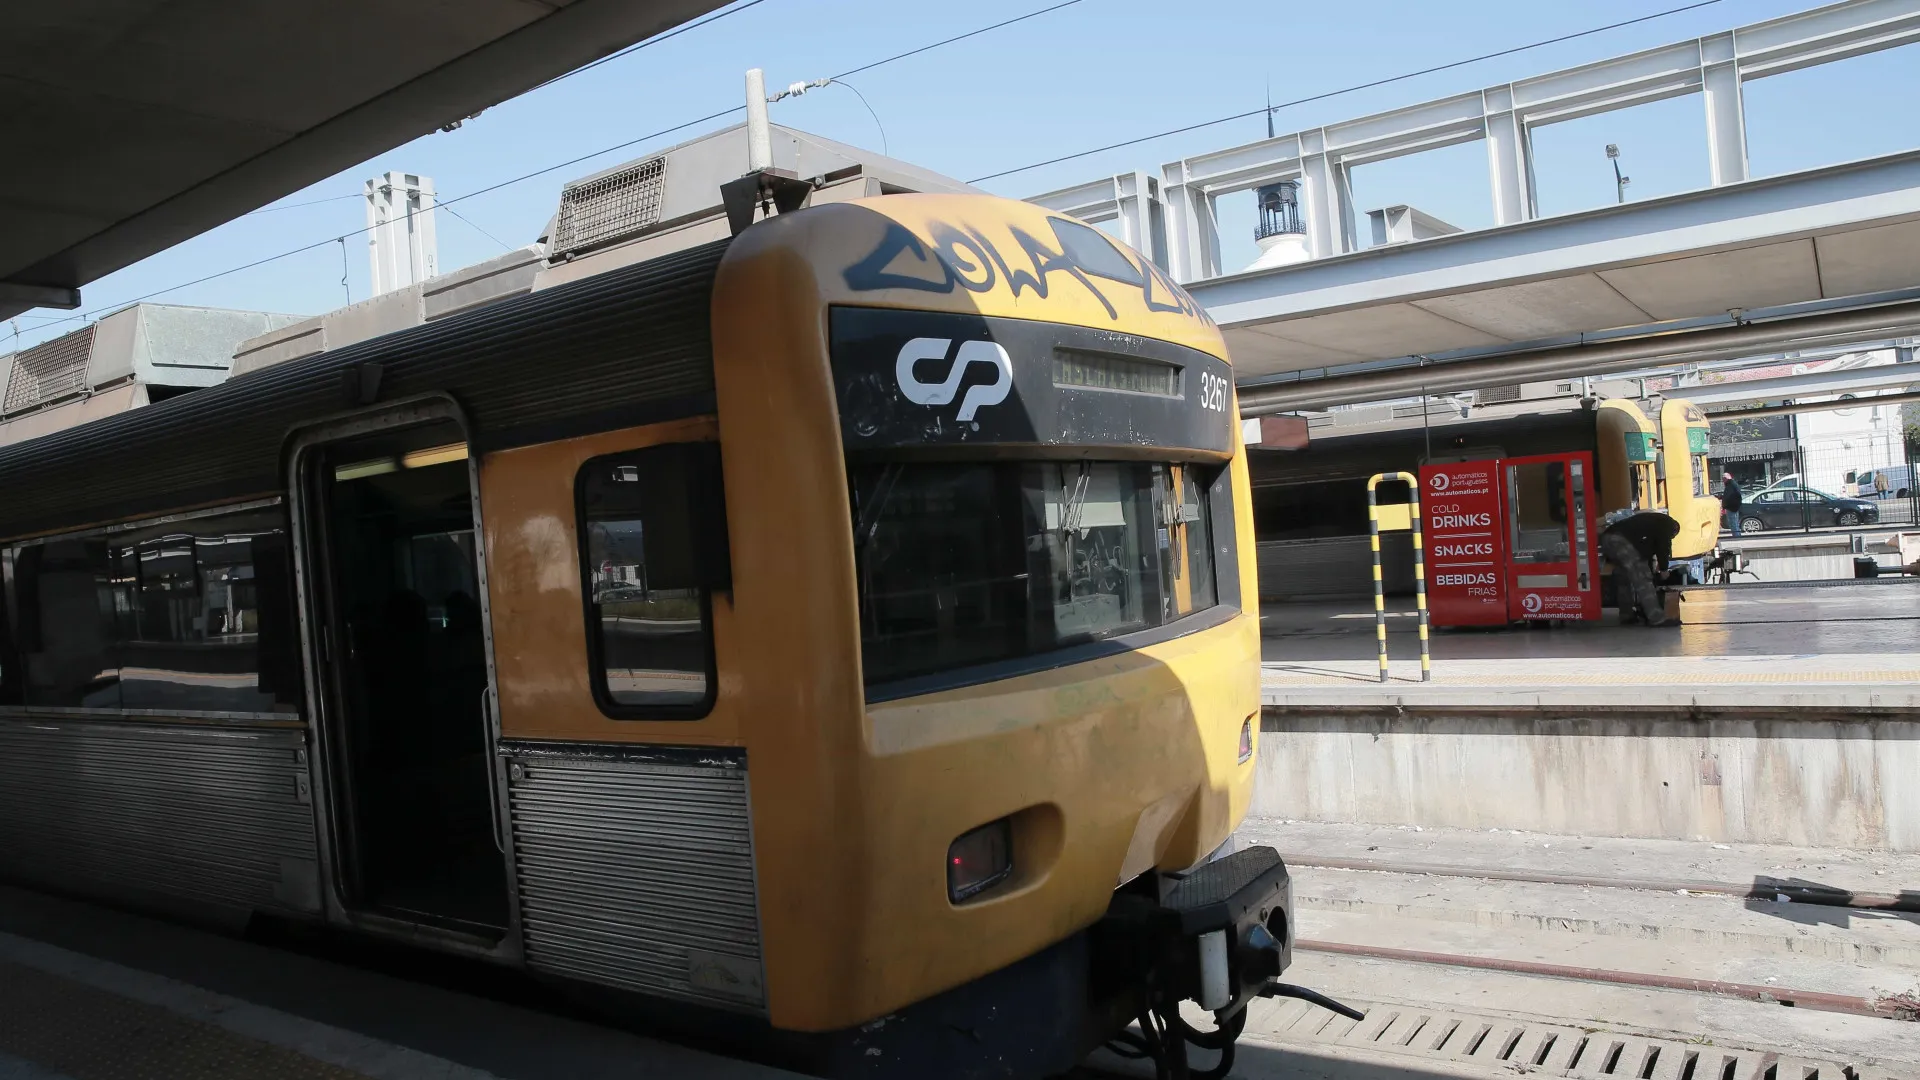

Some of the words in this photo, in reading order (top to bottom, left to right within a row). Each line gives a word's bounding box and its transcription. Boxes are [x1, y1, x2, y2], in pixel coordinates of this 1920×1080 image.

[1200, 371, 1228, 412] 3267
[1752, 453, 1774, 461] SANTOS
[1452, 478, 1488, 487] portugueses
[1430, 488, 1489, 496] www.automaticos.pt
[1431, 504, 1460, 514] COLD
[1432, 513, 1491, 529] DRINKS
[1434, 543, 1493, 556] SNACKS
[1436, 572, 1496, 586] BEBIDAS
[1468, 587, 1497, 596] FRIAS
